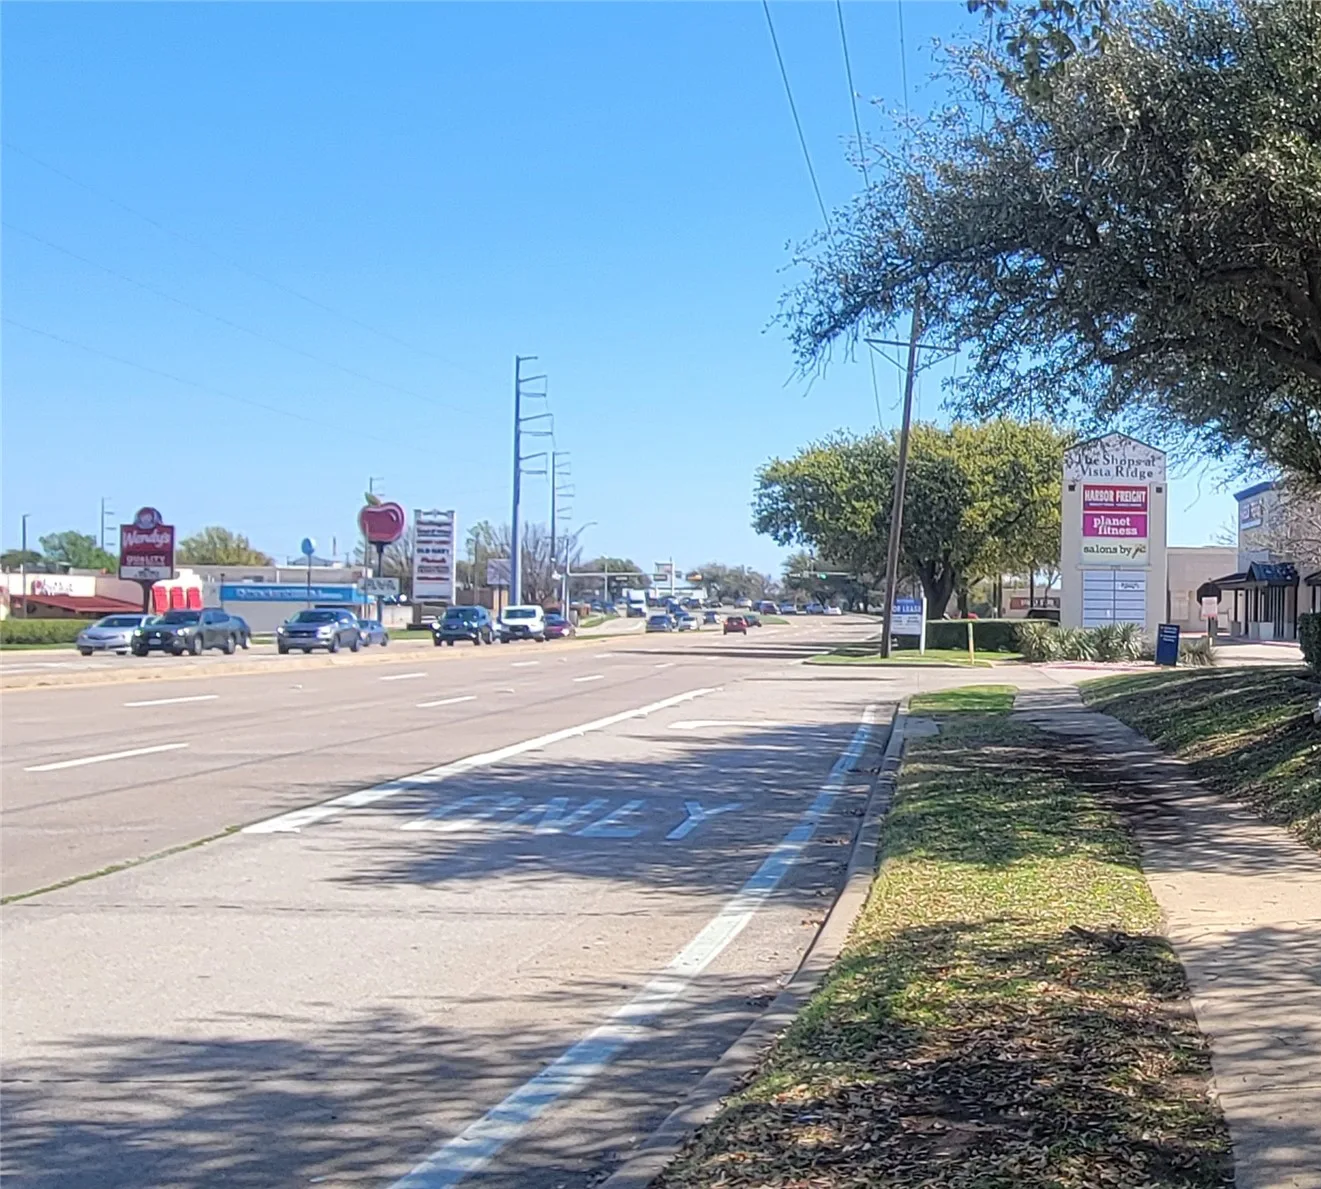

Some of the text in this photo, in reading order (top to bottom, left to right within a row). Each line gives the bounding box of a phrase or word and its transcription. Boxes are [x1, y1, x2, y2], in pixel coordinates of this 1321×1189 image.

[1102, 454, 1143, 469] Shops
[1080, 464, 1154, 480] Vista Ridge
[1084, 489, 1147, 503] HARBOR FREIGHT
[1093, 515, 1130, 528] planet
[1097, 525, 1138, 536] fitness
[1083, 544, 1118, 554] salons
[1119, 545, 1132, 557] by
[400, 792, 743, 839] ONLY
